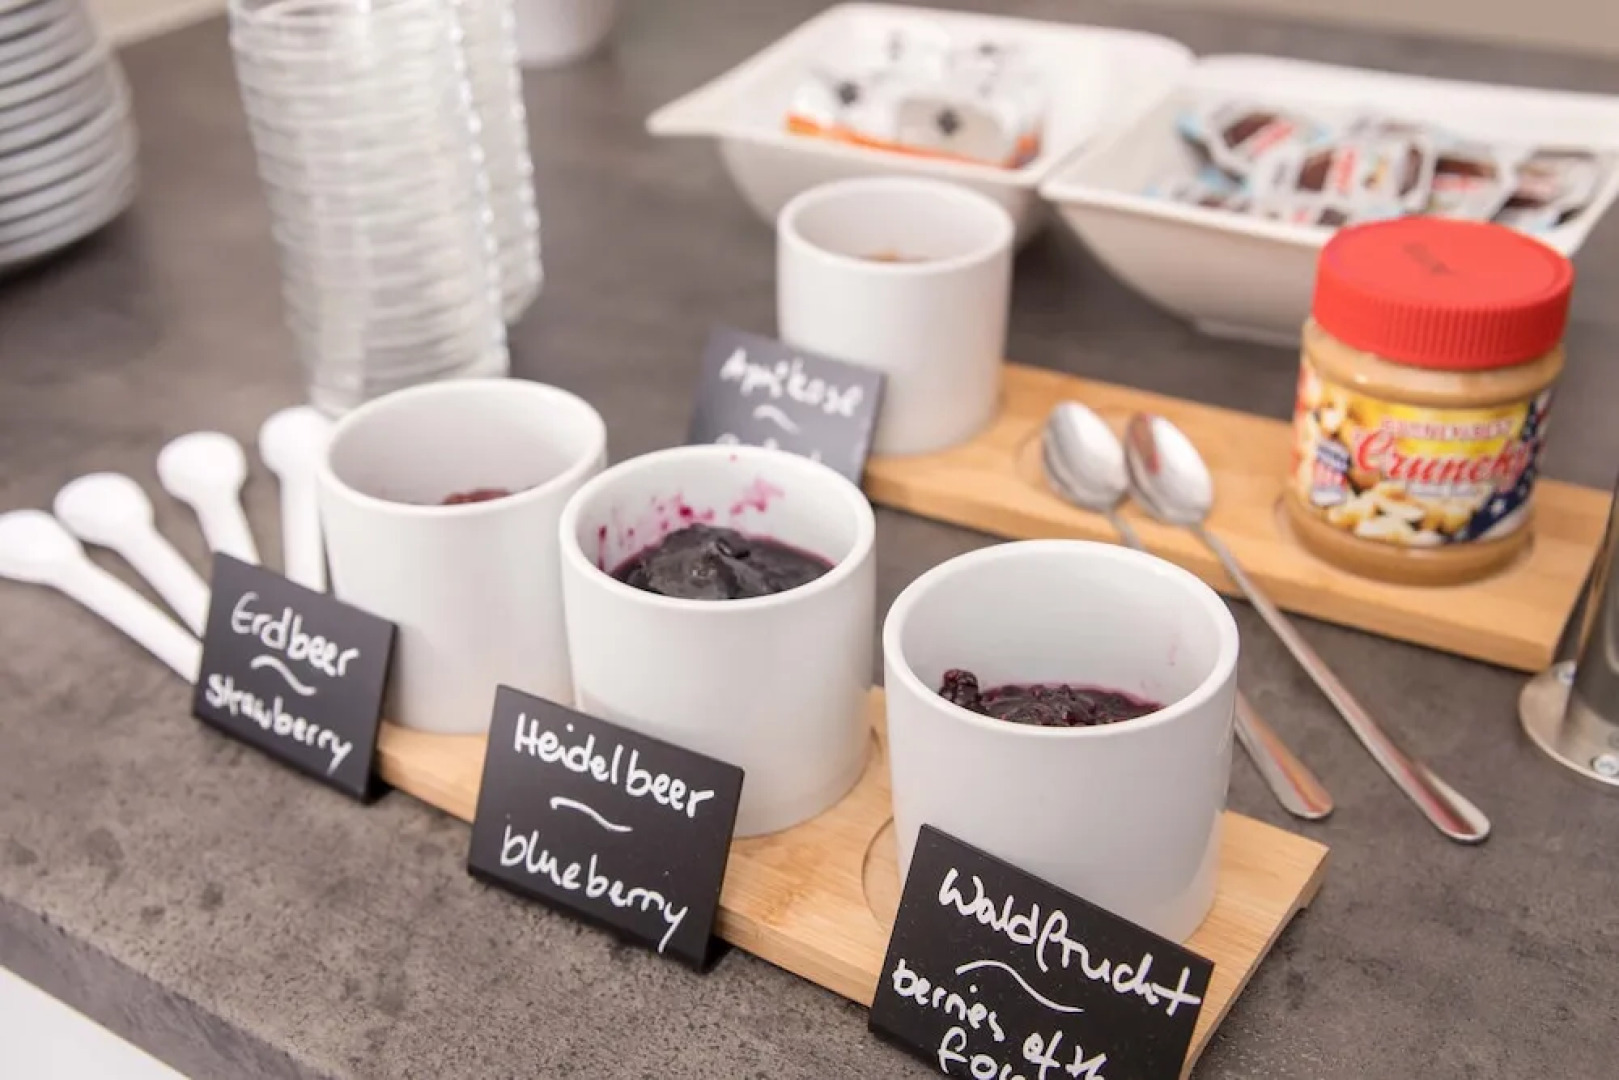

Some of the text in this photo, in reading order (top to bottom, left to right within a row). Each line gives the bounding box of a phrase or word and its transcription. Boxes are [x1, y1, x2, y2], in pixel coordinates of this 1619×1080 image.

[231, 591, 359, 676] Erdbeer
[514, 712, 715, 818] Heidelbeer
[500, 824, 689, 953] blueberry
[938, 867, 1201, 1016] Waldfrucht
[892, 957, 1006, 1042] berries
[1022, 1030, 1063, 1080] of
